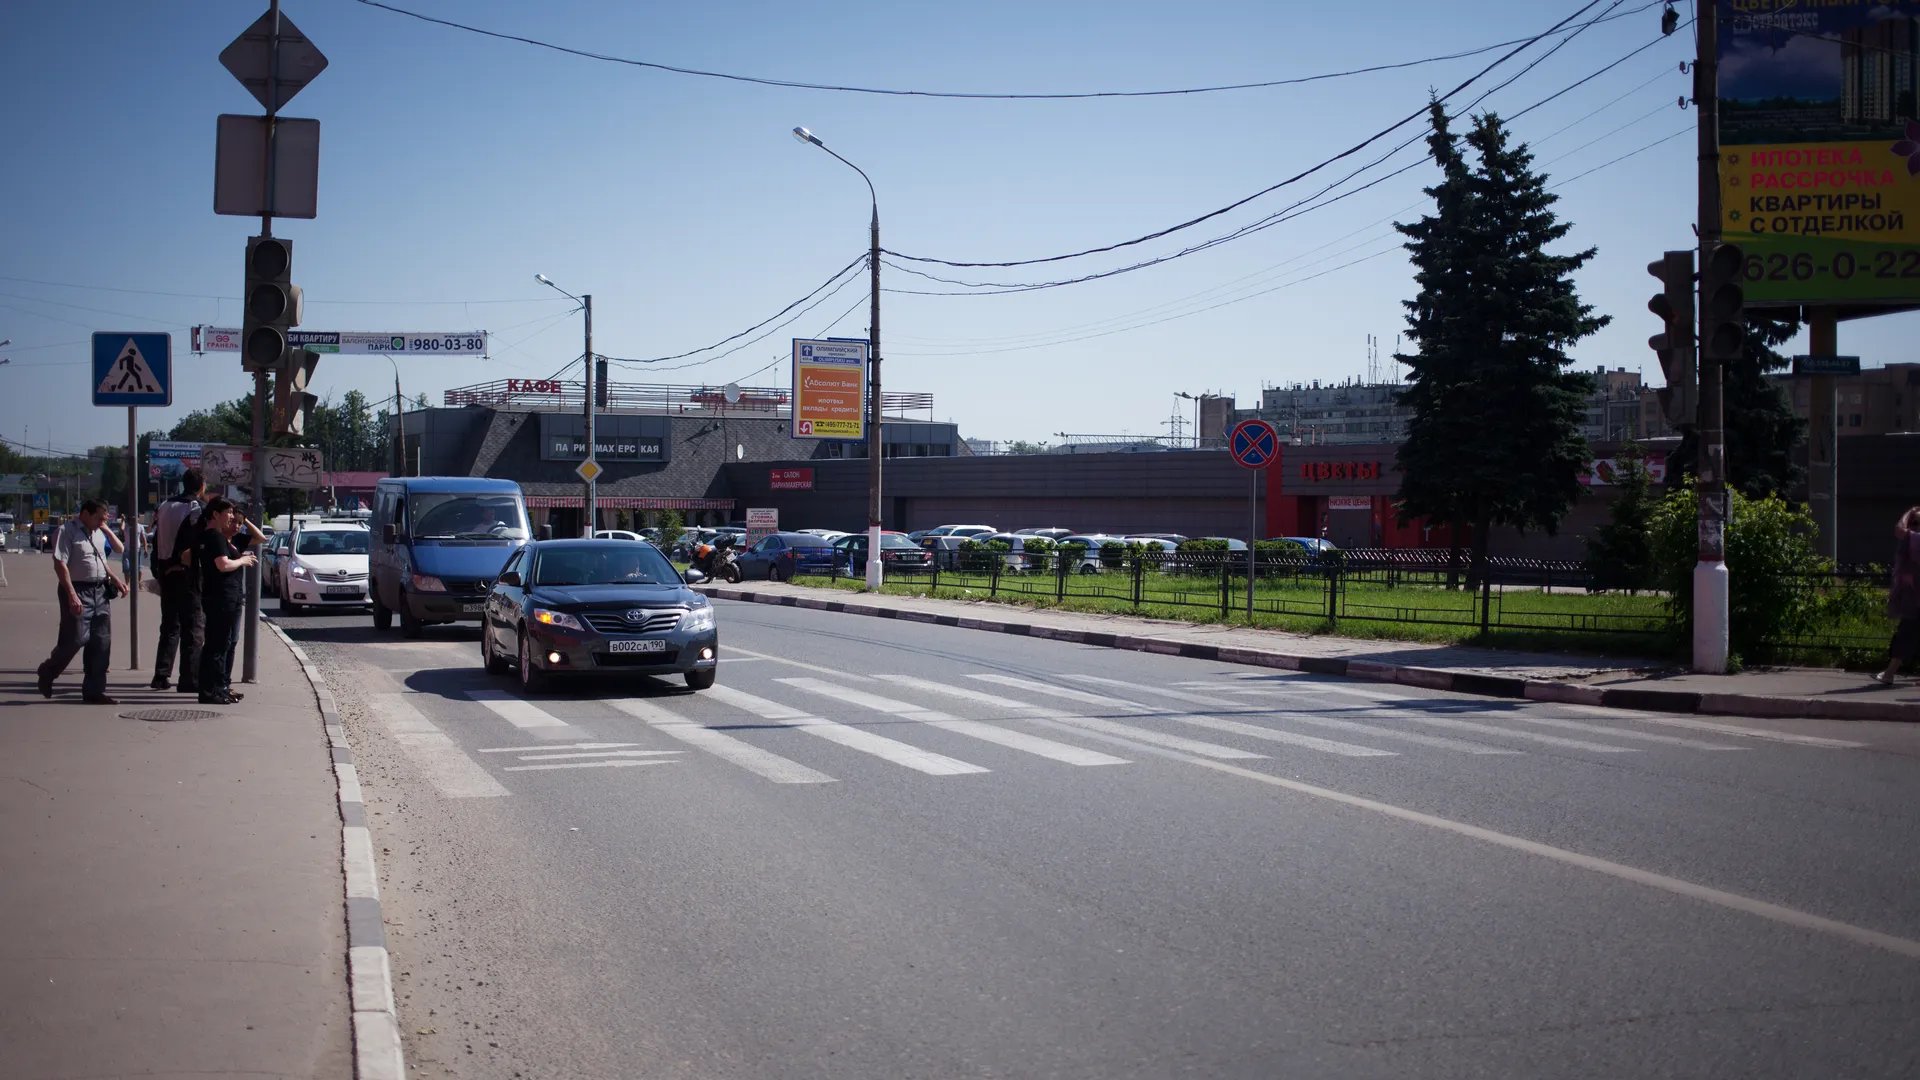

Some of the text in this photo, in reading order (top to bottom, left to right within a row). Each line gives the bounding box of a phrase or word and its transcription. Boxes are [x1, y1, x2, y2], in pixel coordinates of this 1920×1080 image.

[1751, 148, 1863, 168] ИПОТЕКА
[1751, 169, 1895, 190] РАССРОЧКА
[1750, 193, 1881, 213] КВАРТИРЫ
[1750, 210, 1904, 236] С ОТДЕЛКОЙ
[300, 334, 337, 343] КВАРТИРУ
[414, 338, 483, 350] 980-03-80
[507, 379, 562, 394] КАФЕ
[809, 379, 840, 387] Абсолют
[802, 405, 828, 413] вклады
[783, 471, 800, 479] САЛОН
[1300, 460, 1381, 482] ЦВЕТЫ
[1328, 497, 1371, 507] НИЗКИЕ ЦЕНЫ
[649, 640, 664, 648] 190
